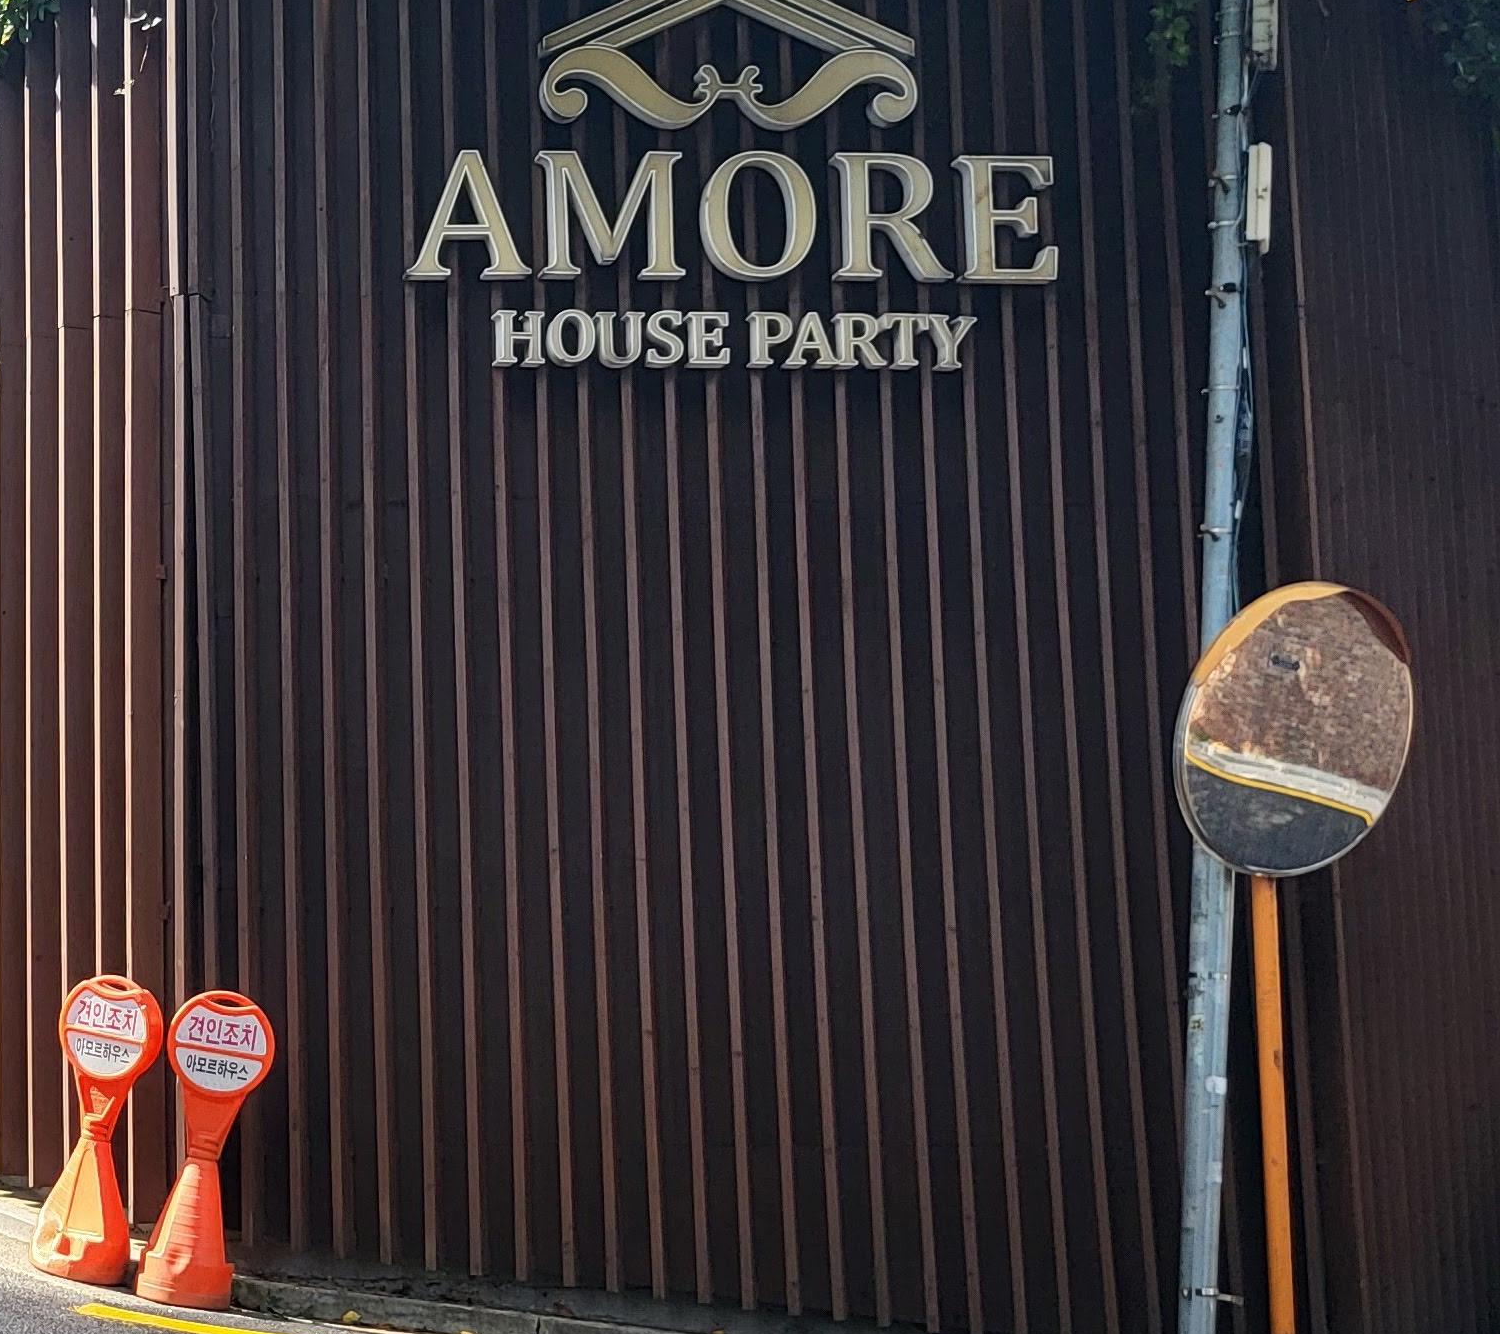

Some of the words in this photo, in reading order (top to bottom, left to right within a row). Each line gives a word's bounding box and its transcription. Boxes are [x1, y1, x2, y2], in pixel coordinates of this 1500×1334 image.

[405, 149, 1058, 285] AMORE
[491, 309, 730, 367] HOUSE
[746, 312, 977, 370] PARTY
[77, 999, 138, 1036] 견인조치
[188, 1016, 258, 1051] 견인조치
[76, 1038, 130, 1063] 아모르하우스
[186, 1054, 249, 1080] 아모르하우스
